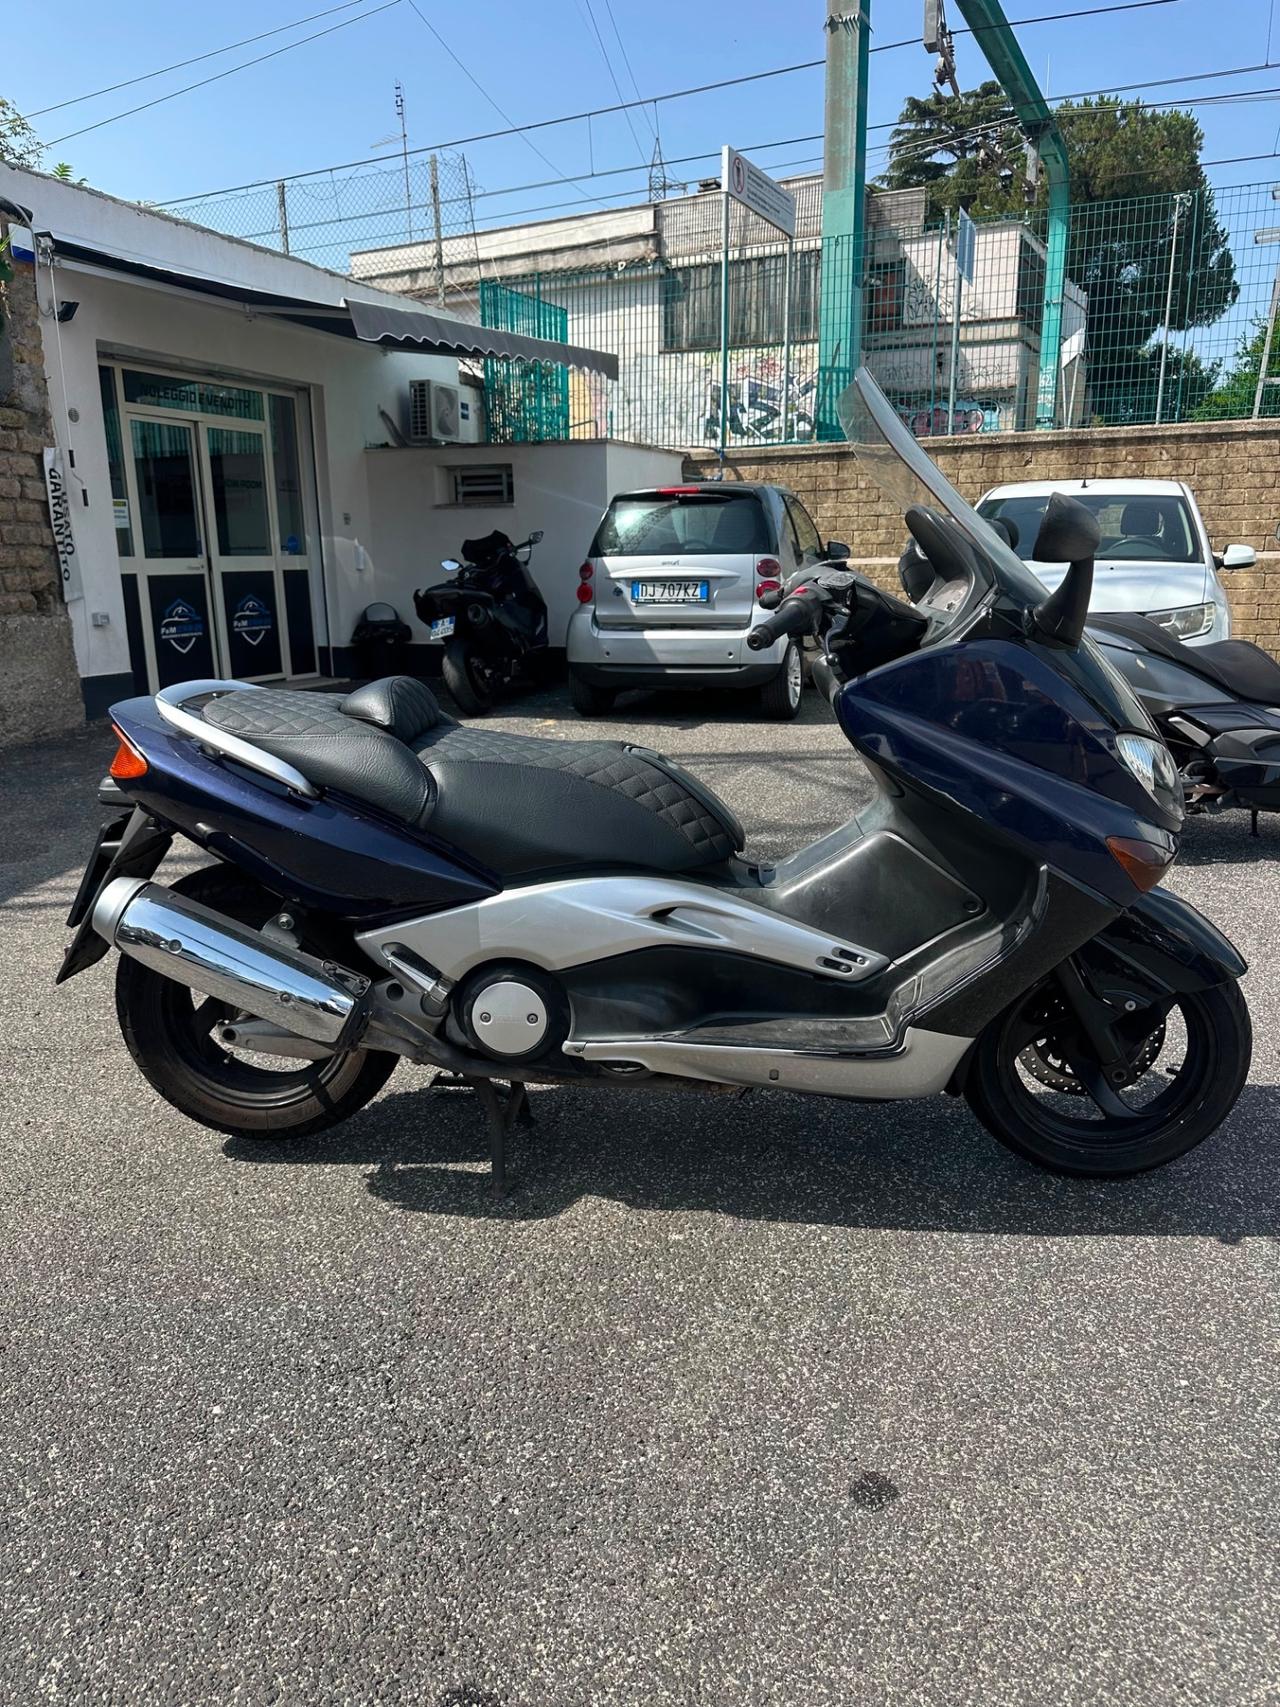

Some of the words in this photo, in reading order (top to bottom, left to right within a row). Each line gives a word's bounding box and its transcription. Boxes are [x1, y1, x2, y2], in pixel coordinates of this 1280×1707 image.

[205, 394, 250, 410] VENDITA
[48, 467, 71, 582] GARANTITO
[61, 491, 76, 556] USATO
[640, 583, 656, 598] DJ
[660, 583, 699, 598] 707KZ
